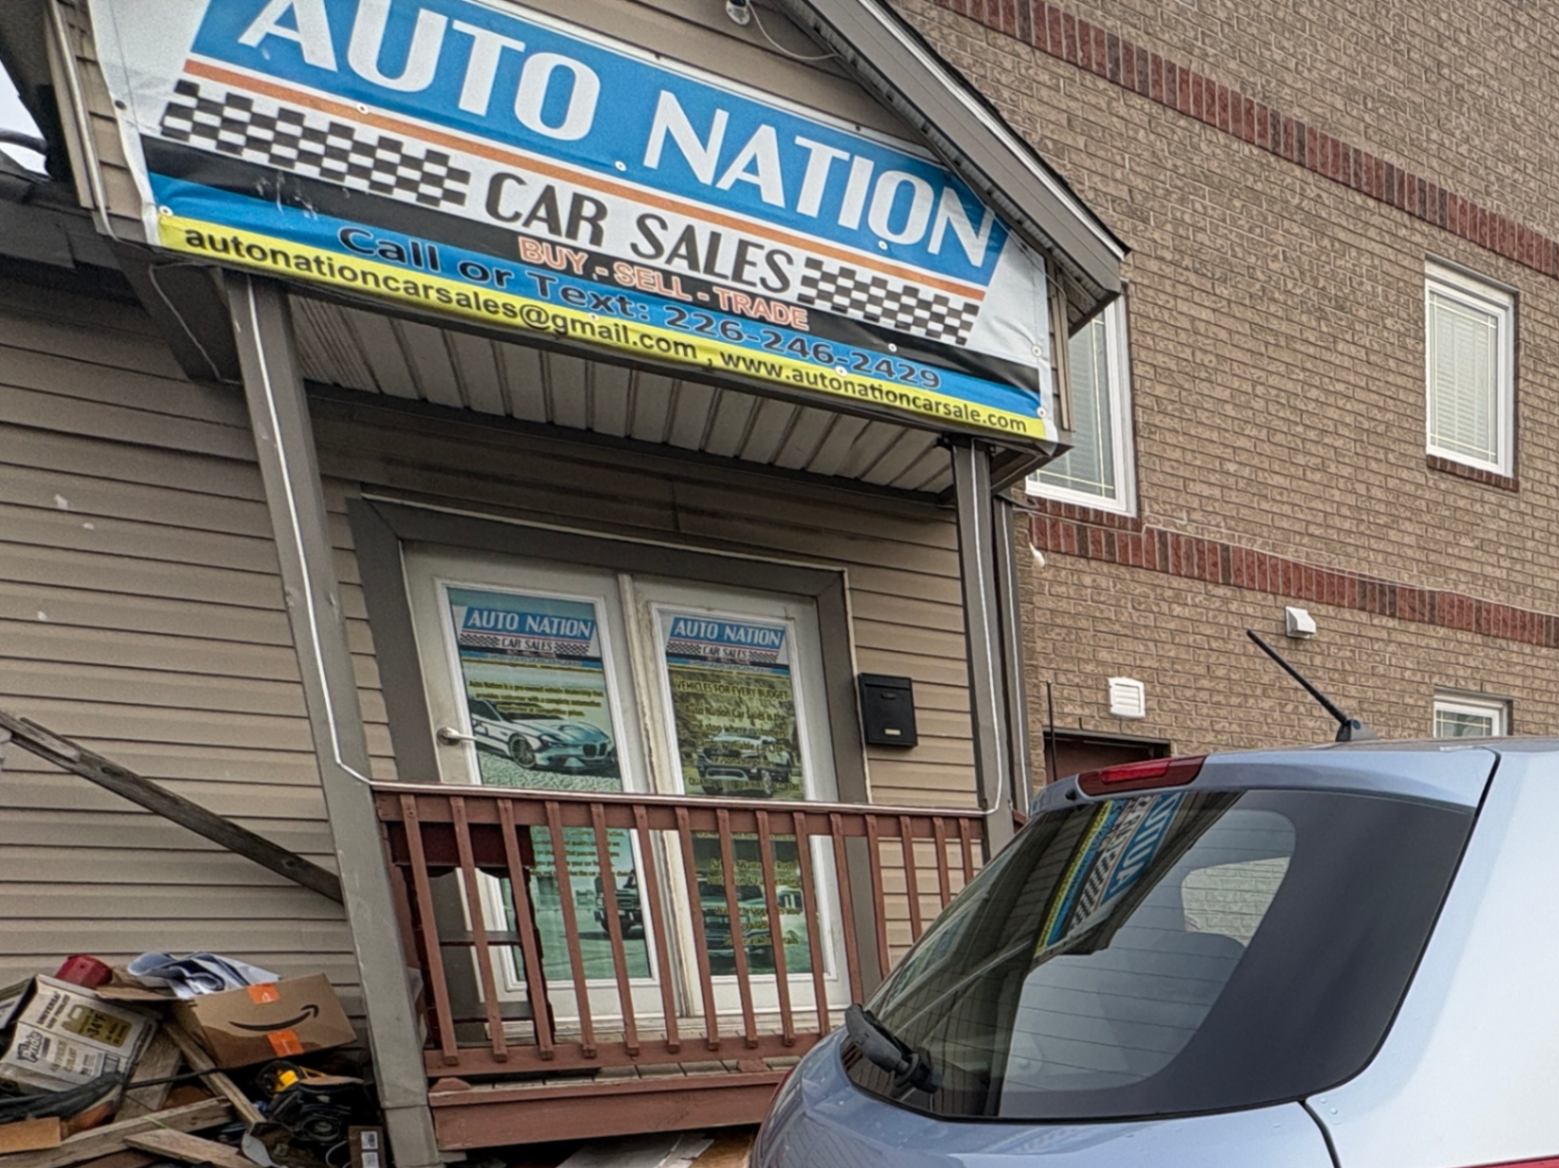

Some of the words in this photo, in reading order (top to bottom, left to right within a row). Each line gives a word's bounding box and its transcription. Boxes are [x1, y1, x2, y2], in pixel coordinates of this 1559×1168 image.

[238, 0, 601, 142] AUTO
[643, 89, 995, 268] NATION
[485, 172, 608, 247] CAR
[630, 212, 794, 294] SALES
[518, 235, 589, 276] BUY
[613, 261, 693, 303] SELL
[711, 285, 811, 332] TRADE
[184, 227, 697, 361] autonationcarsales@gmail.com
[719, 348, 1028, 433] www.autonationcarsale.com
[338, 226, 441, 272] Call
[456, 259, 514, 288] or
[526, 271, 651, 321] Text:
[663, 303, 942, 391] 226-246-2429
[467, 609, 520, 631] AUTO
[525, 614, 592, 639] NATION
[501, 637, 522, 650] CAR
[524, 639, 554, 652] SALES
[673, 619, 719, 640] AUTO
[723, 625, 782, 647] NATION
